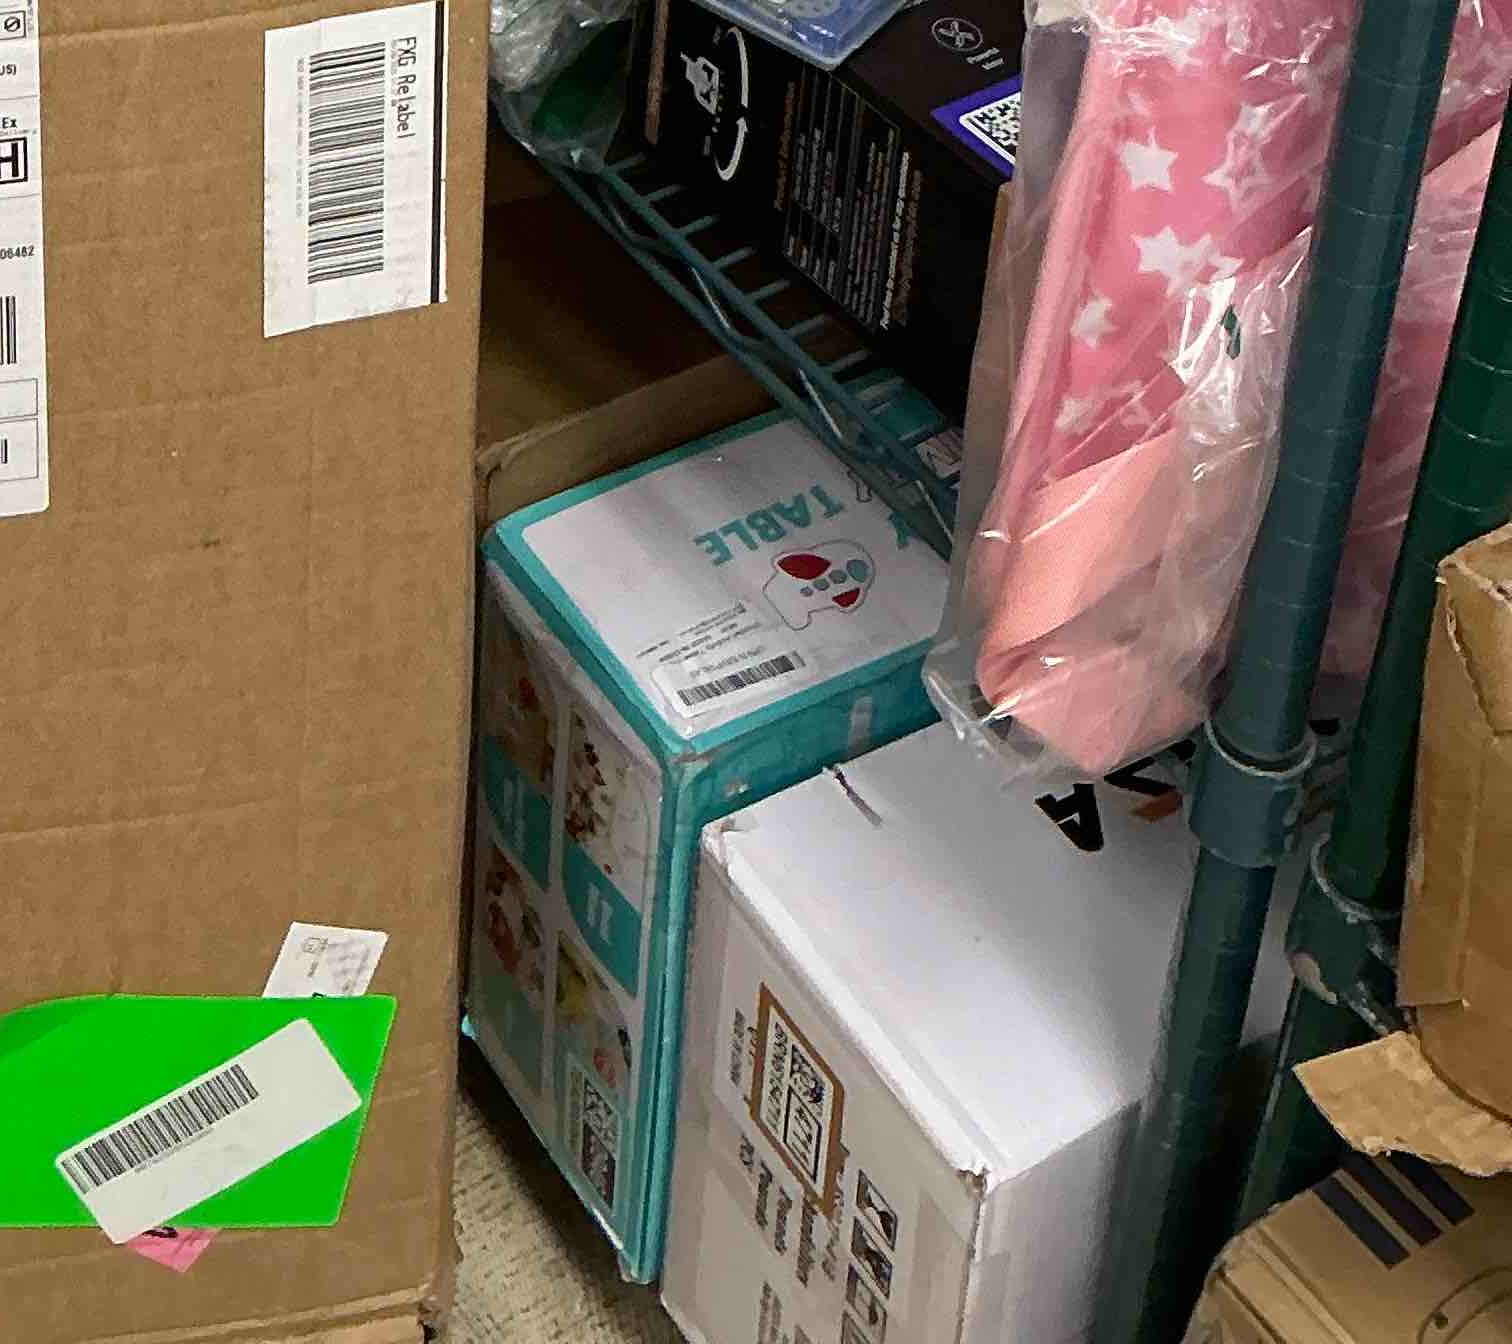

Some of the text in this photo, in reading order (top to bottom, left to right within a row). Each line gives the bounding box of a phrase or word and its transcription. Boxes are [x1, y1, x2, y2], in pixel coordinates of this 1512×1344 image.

[396, 36, 418, 139] FXG Relabel
[693, 483, 845, 568] TABLE
